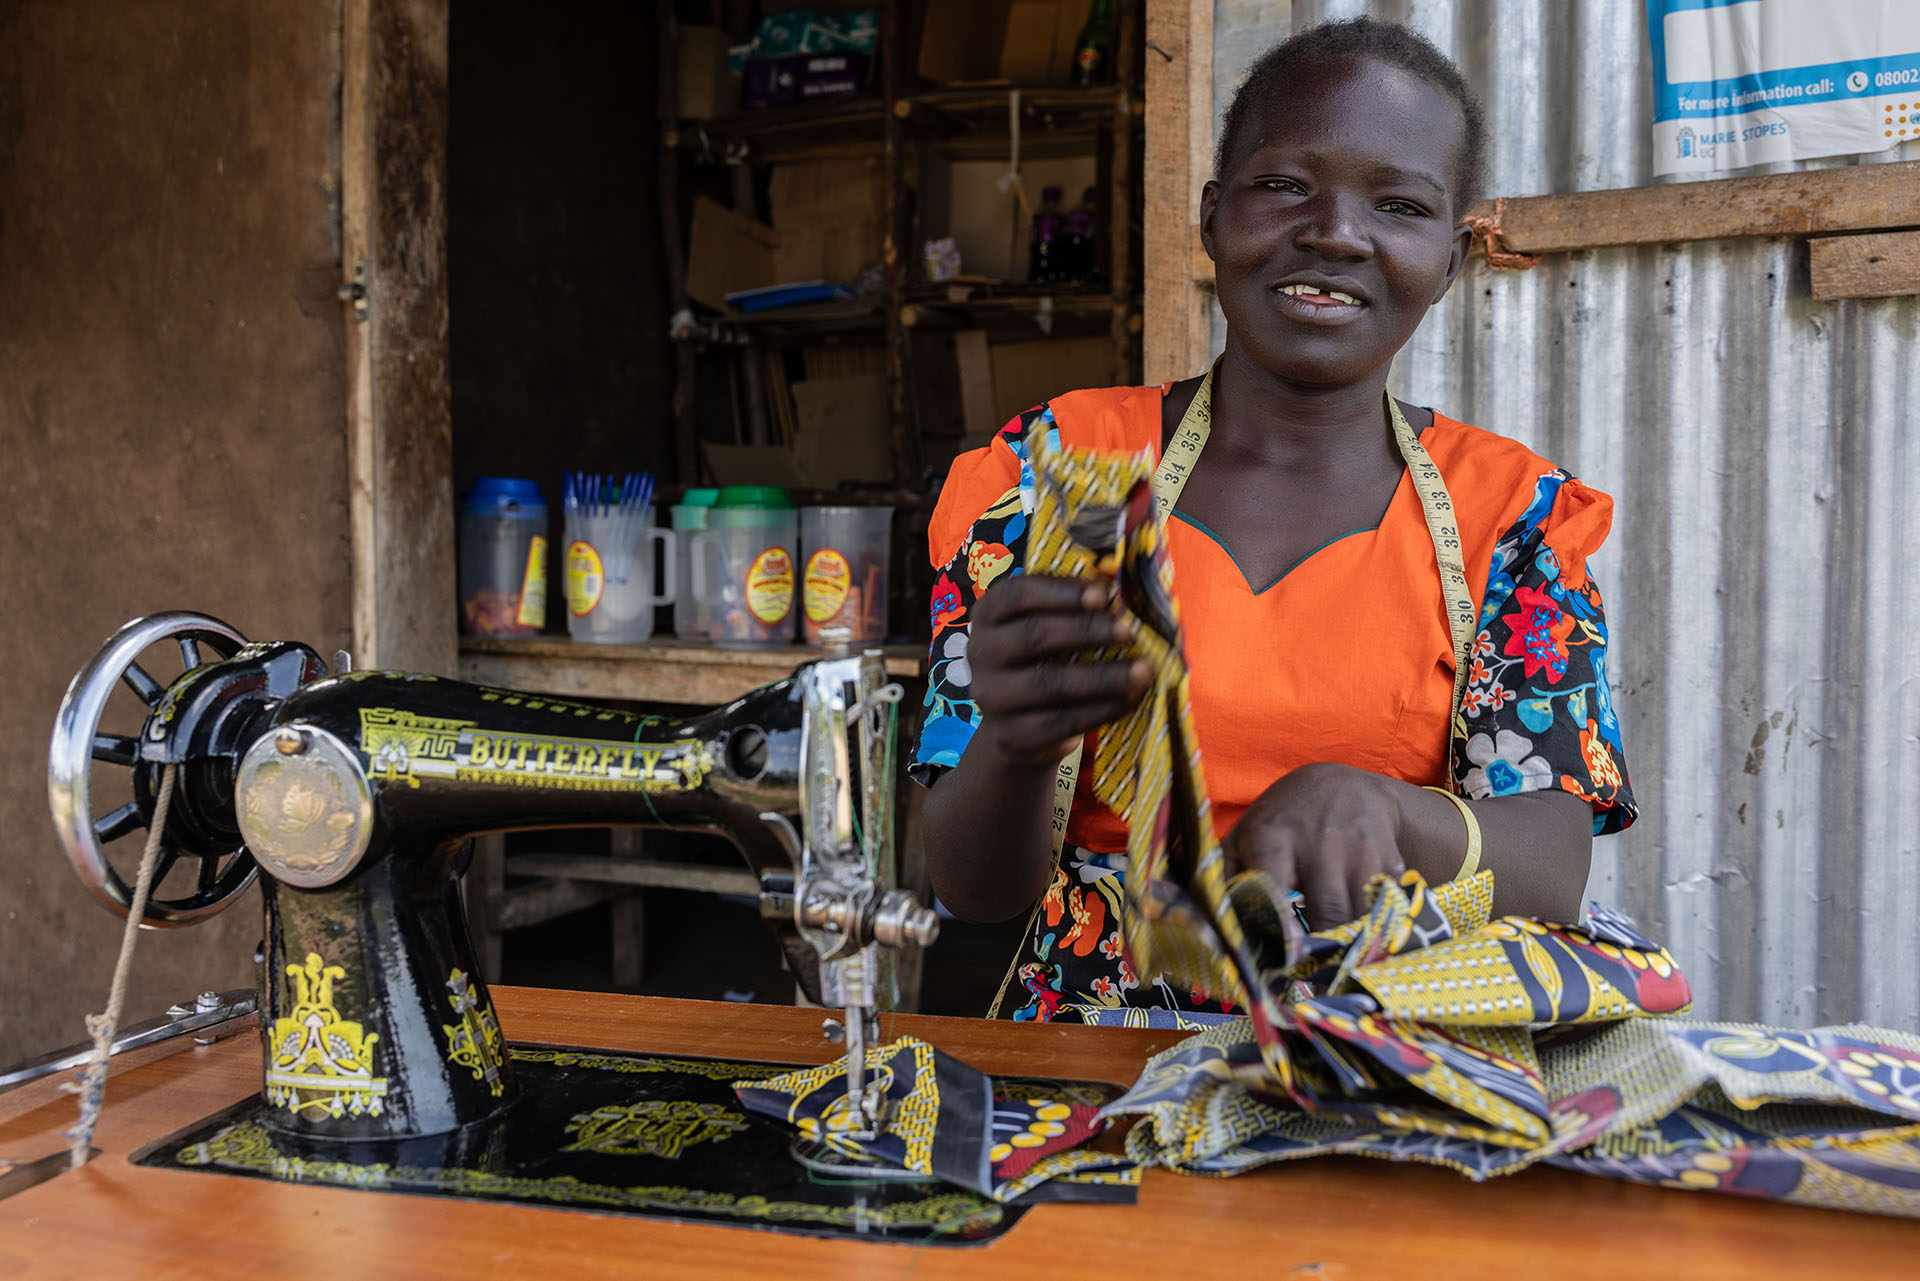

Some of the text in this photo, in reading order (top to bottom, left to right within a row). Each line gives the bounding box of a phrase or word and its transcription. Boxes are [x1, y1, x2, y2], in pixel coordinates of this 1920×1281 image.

[1678, 97, 1697, 111] For
[1699, 96, 1730, 111] more
[1731, 84, 1802, 107] information
[1805, 78, 1835, 96] call:
[1700, 122, 1787, 146] MARIE STOPES
[1164, 462, 1186, 485] 34
[1180, 429, 1201, 452] 35
[1418, 462, 1439, 480] 34
[1431, 491, 1451, 511] 33
[1441, 526, 1459, 549] 32
[1457, 600, 1475, 624] 30
[469, 735, 663, 780] BUTTERFLY
[1057, 764, 1074, 790] 26
[1052, 806, 1066, 832] 25
